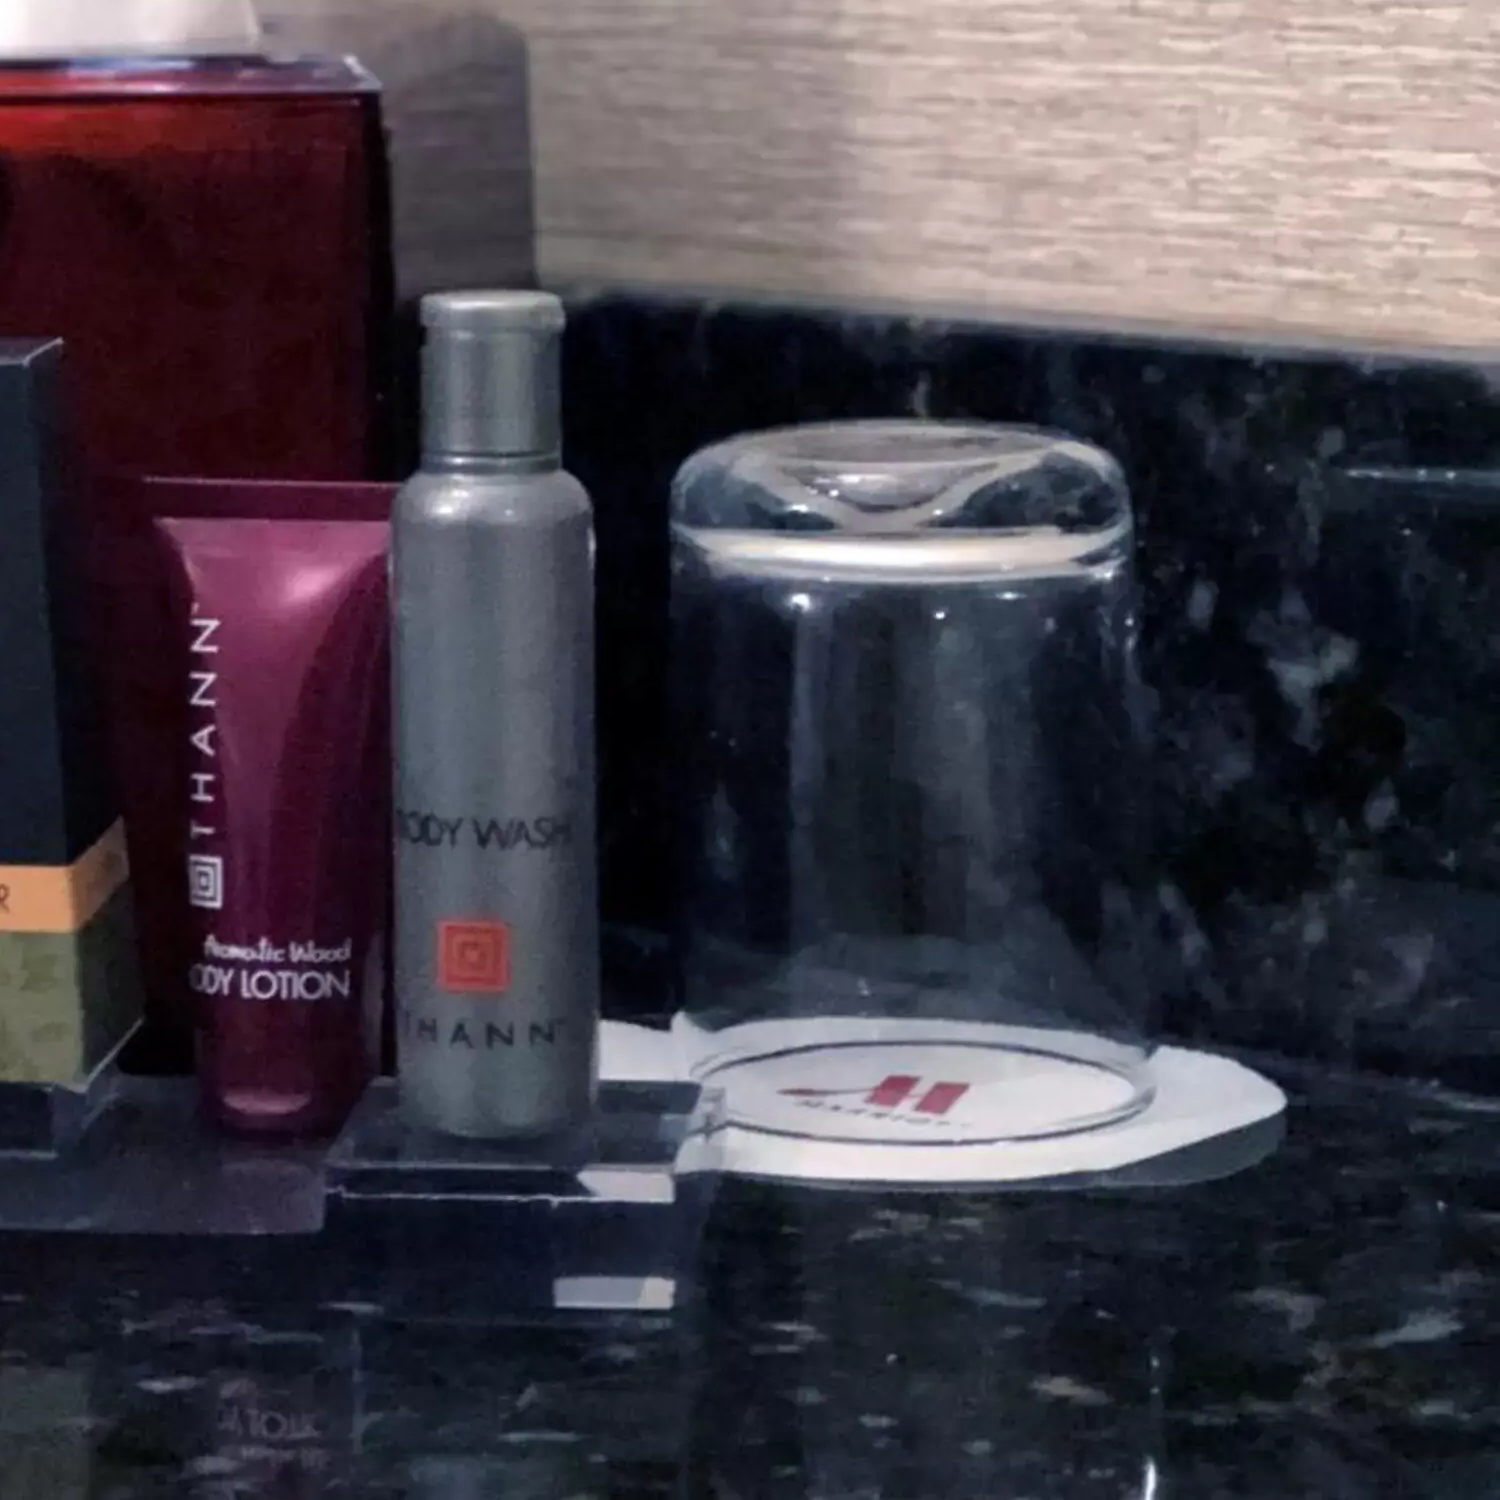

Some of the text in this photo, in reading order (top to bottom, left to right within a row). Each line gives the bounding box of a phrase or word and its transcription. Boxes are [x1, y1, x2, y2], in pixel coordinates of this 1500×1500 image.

[189, 618, 221, 839] THANN
[471, 815, 572, 850] WASH
[240, 969, 350, 999] LOTION
